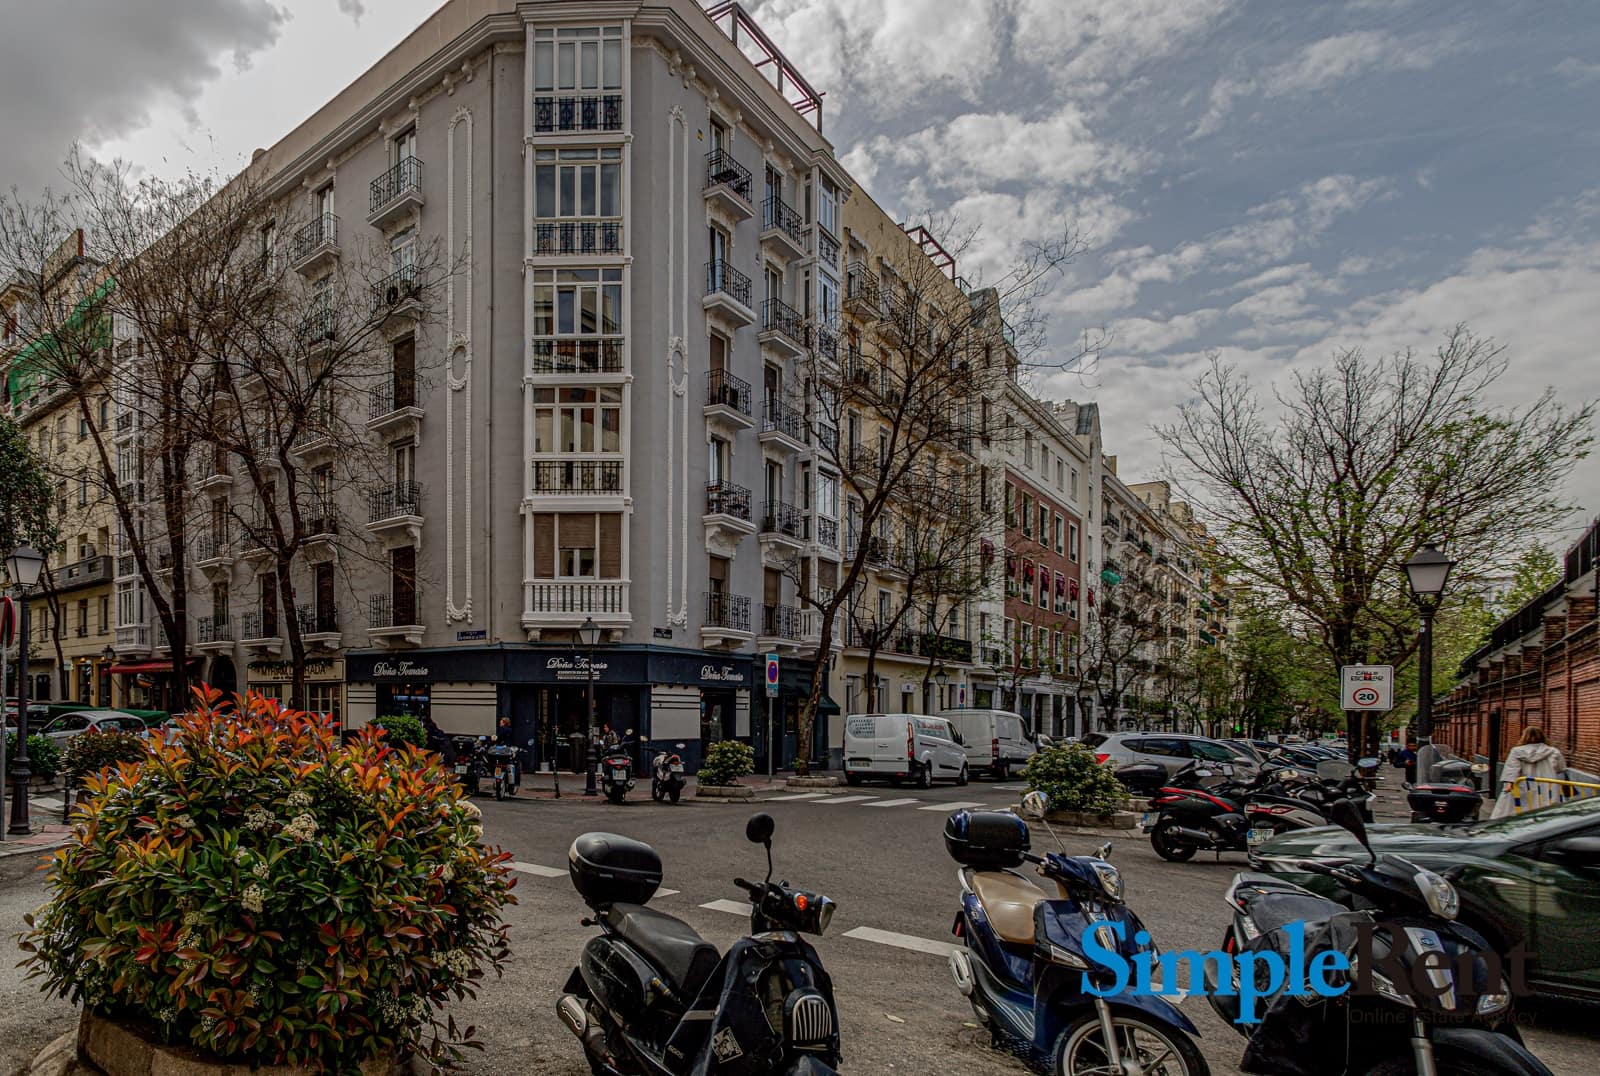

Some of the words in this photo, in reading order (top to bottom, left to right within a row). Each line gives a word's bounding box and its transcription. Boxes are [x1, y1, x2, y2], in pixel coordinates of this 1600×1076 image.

[372, 662, 396, 676] Doña
[397, 661, 429, 676] Tomasa
[546, 657, 574, 669] Doña
[700, 664, 721, 680] Doña
[720, 665, 744, 682] Tomasa
